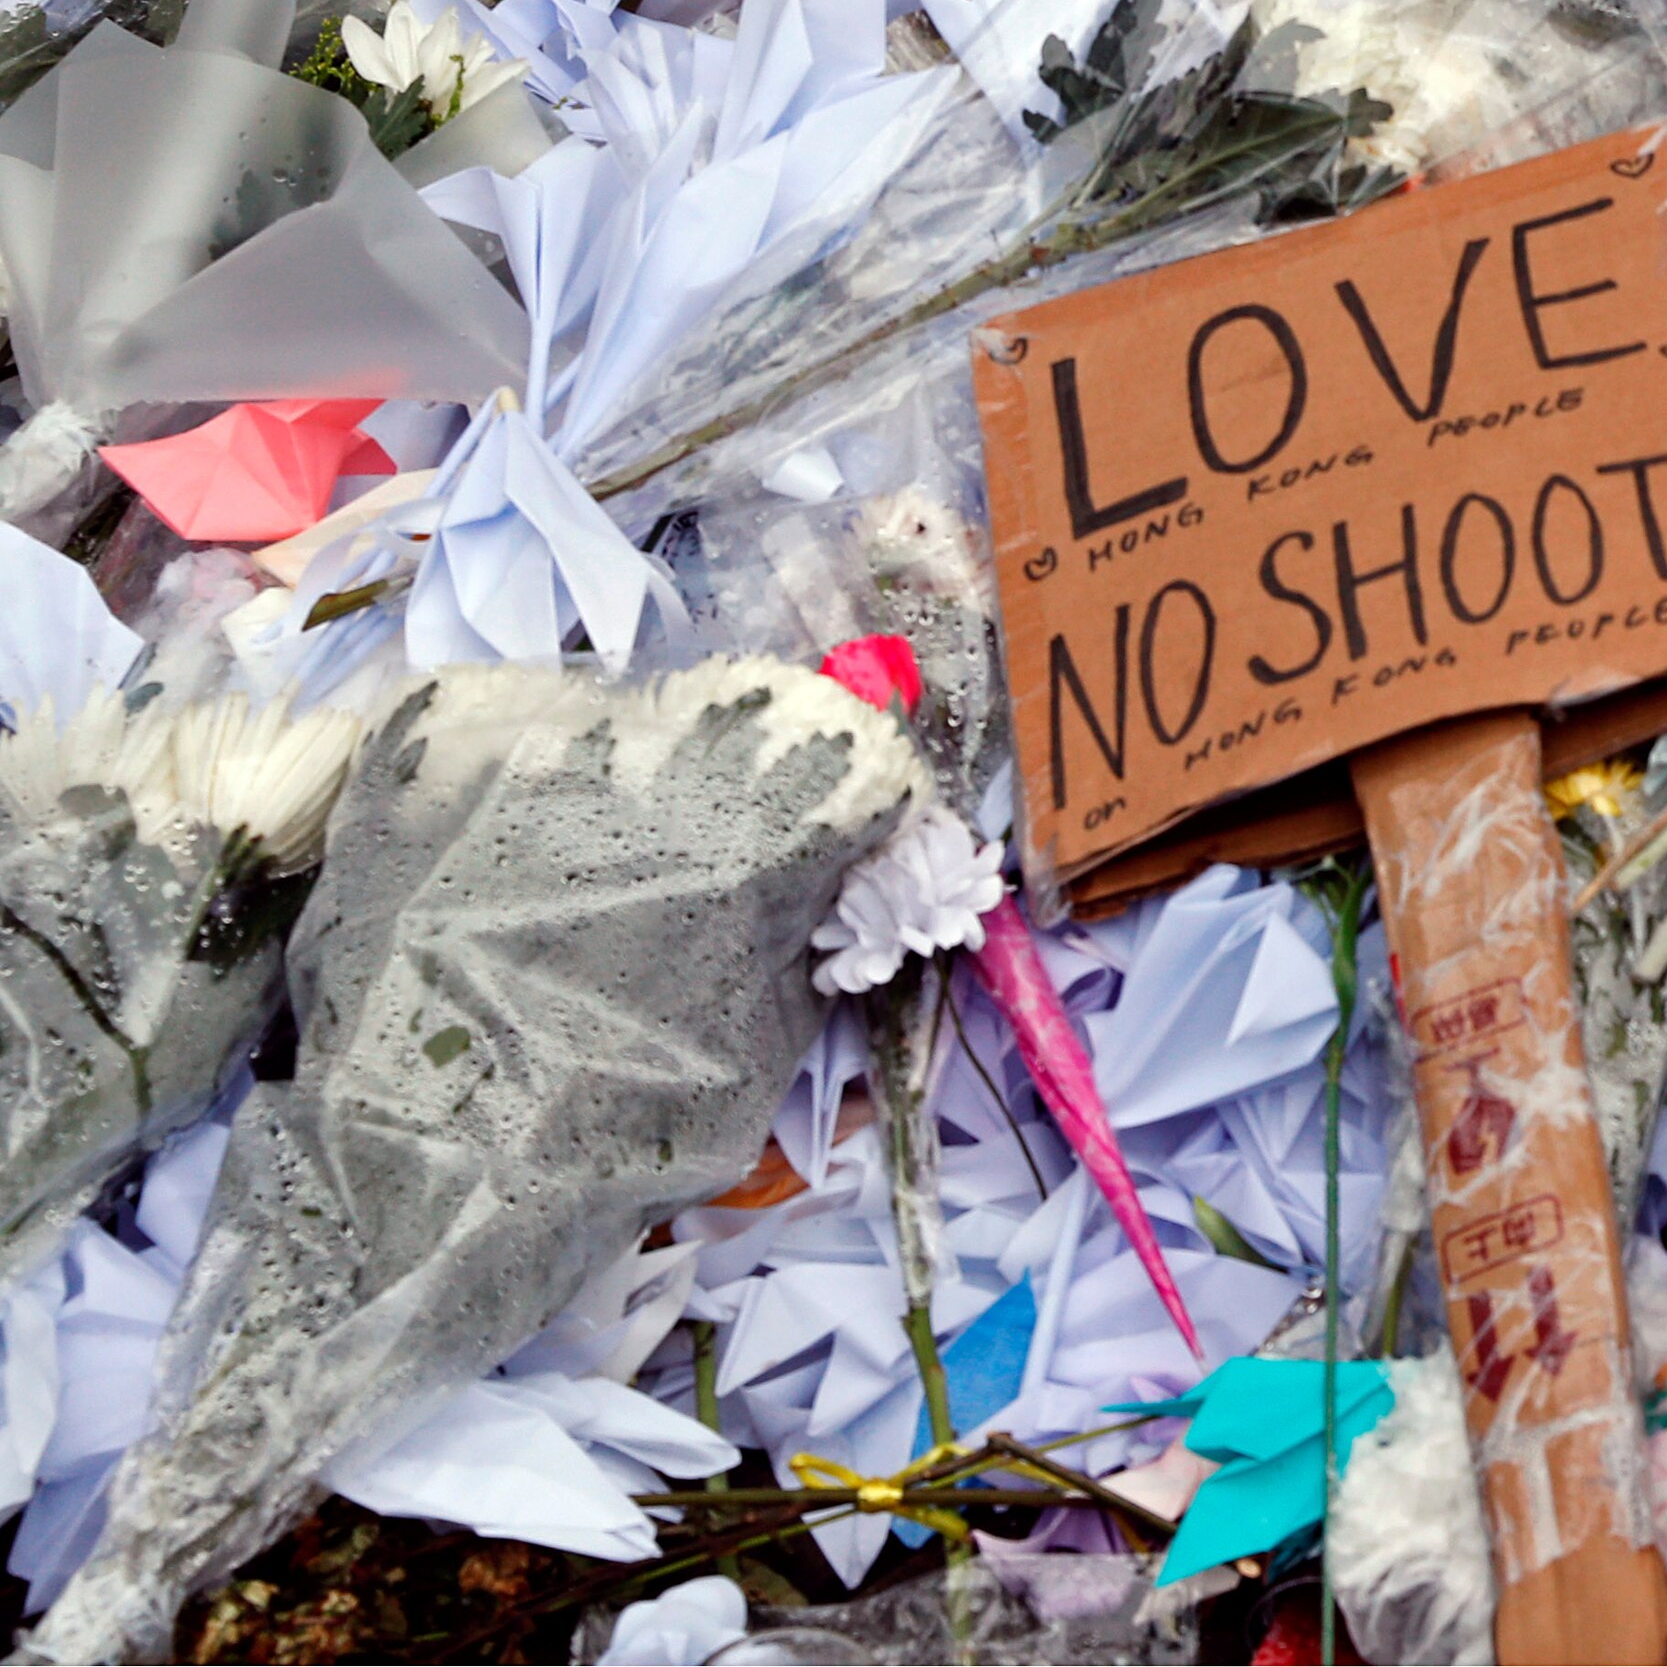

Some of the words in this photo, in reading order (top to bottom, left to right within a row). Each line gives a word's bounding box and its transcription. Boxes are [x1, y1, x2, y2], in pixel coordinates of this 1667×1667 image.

[1051, 198, 1647, 541] LOVE
[1087, 505, 1205, 571] HONG
[1246, 444, 1375, 504] KONG
[1427, 387, 1585, 449] PEOPLE
[1049, 578, 1217, 811] NO
[1183, 697, 1303, 772] HONG
[1330, 645, 1458, 706] KONG
